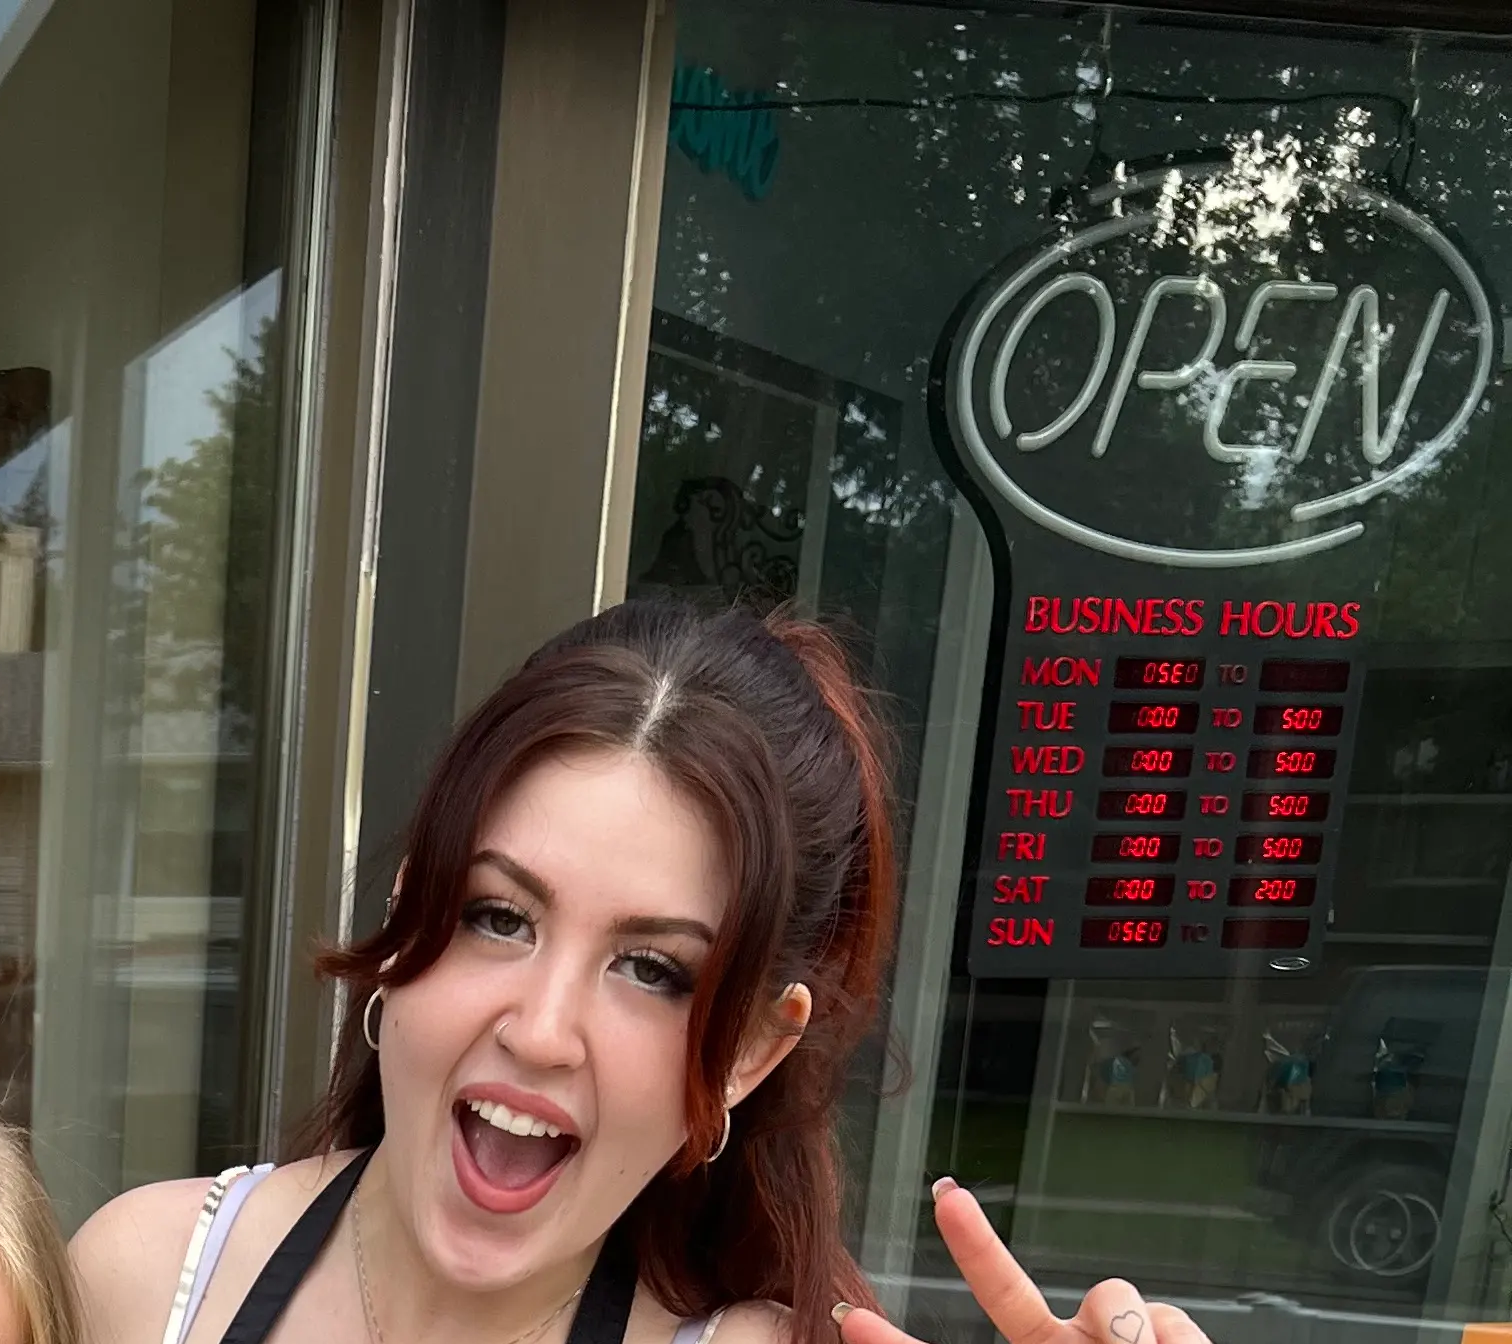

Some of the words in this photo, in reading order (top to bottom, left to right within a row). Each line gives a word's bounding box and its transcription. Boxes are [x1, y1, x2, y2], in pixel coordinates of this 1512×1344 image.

[989, 271, 1450, 466] OPEN
[1025, 596, 1205, 636] BUSINESS
[1219, 600, 1361, 639] HOURS
[1020, 656, 1102, 687] MON
[1220, 664, 1248, 684] TO
[1016, 700, 1077, 731] TUE
[1212, 708, 1242, 728] TO
[1011, 745, 1084, 775] WED
[1205, 752, 1236, 772] TO
[1006, 789, 1074, 818] THU
[1199, 795, 1230, 815] TO
[998, 832, 1047, 861] FRI
[1192, 838, 1224, 858] TO
[993, 875, 1050, 904] SAT
[1187, 880, 1217, 901] TO
[987, 918, 1054, 946] SUN
[1181, 923, 1211, 943] TO
